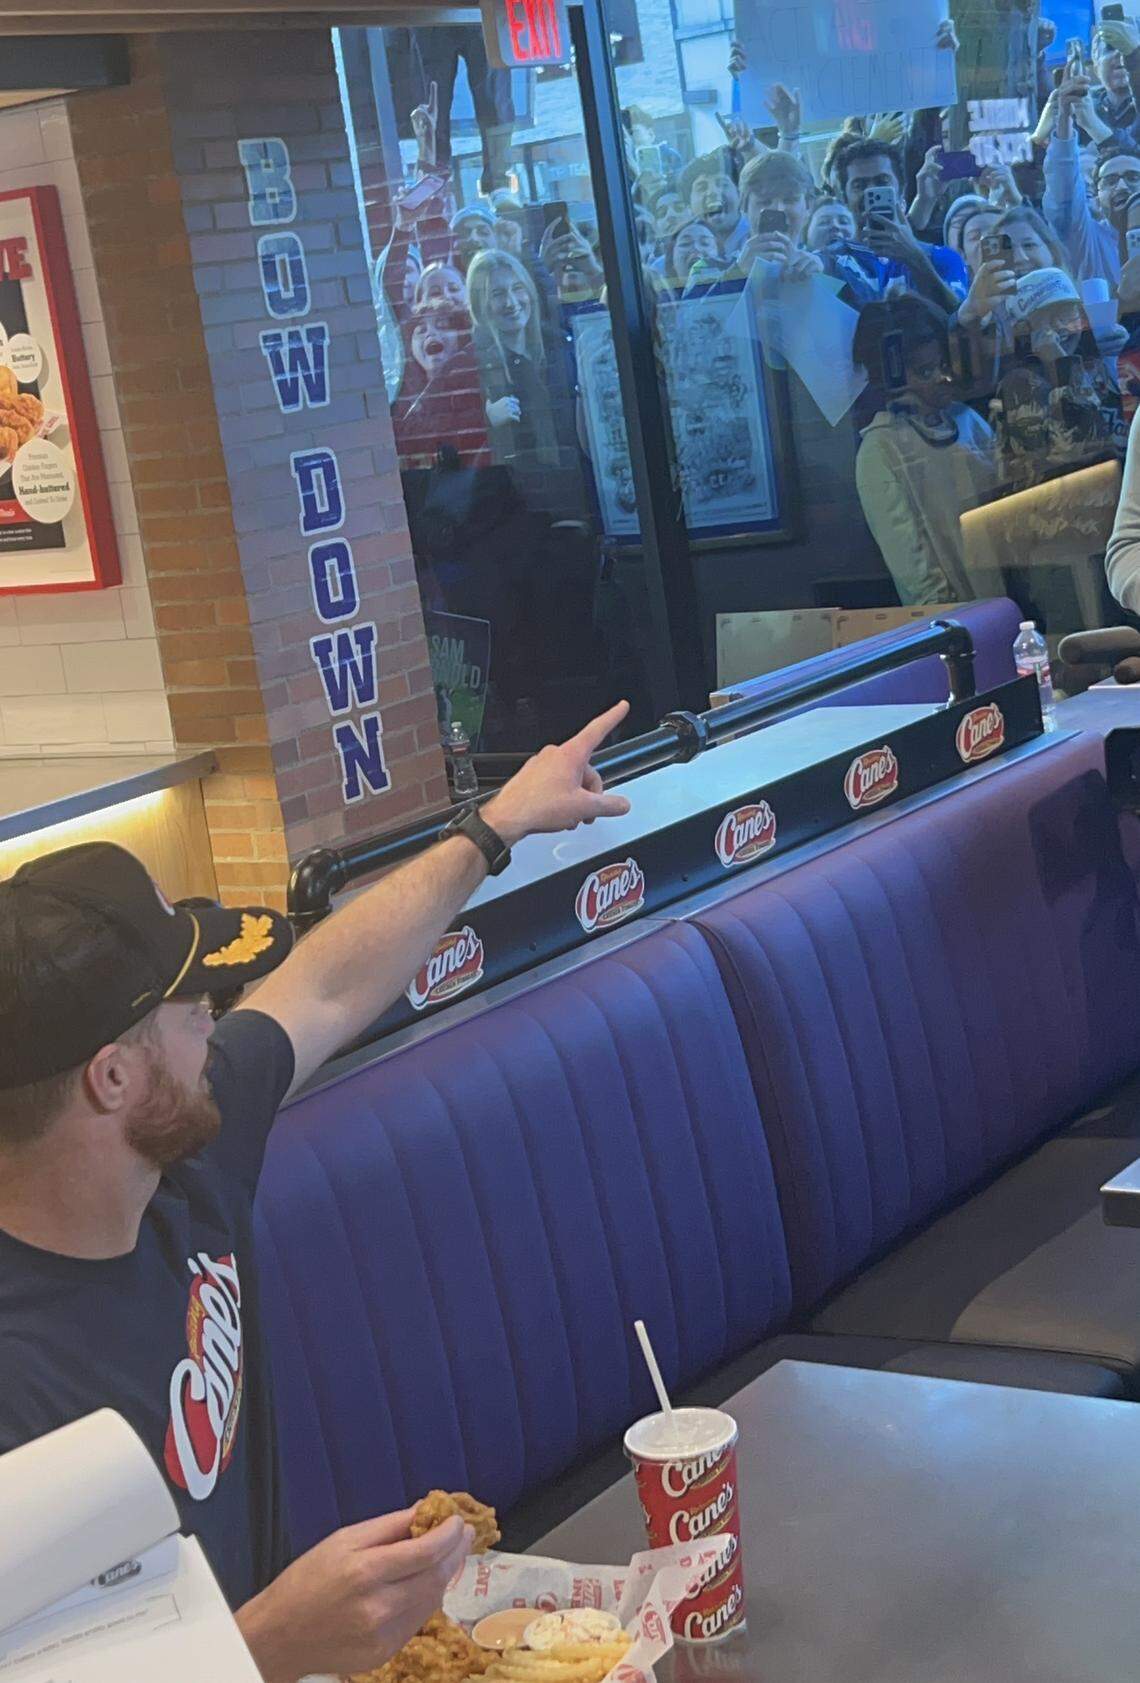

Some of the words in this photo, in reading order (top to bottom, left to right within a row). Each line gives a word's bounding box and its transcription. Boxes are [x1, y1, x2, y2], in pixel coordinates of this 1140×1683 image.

[504, 0, 562, 61] EXIT
[0, 236, 33, 281] E
[237, 137, 331, 414] BOW
[289, 446, 391, 805] DOWN
[431, 634, 465, 664] SAM
[960, 704, 1001, 759] Cane's
[849, 747, 895, 806] Cane's
[719, 801, 774, 864] Cane's
[580, 860, 642, 928] Cane's
[170, 1252, 241, 1500] Cane's
[661, 1445, 728, 1497] Cane
[668, 1482, 734, 1547] Cane's
[686, 1536, 738, 1600] anes
[684, 1584, 742, 1640] Cane's
